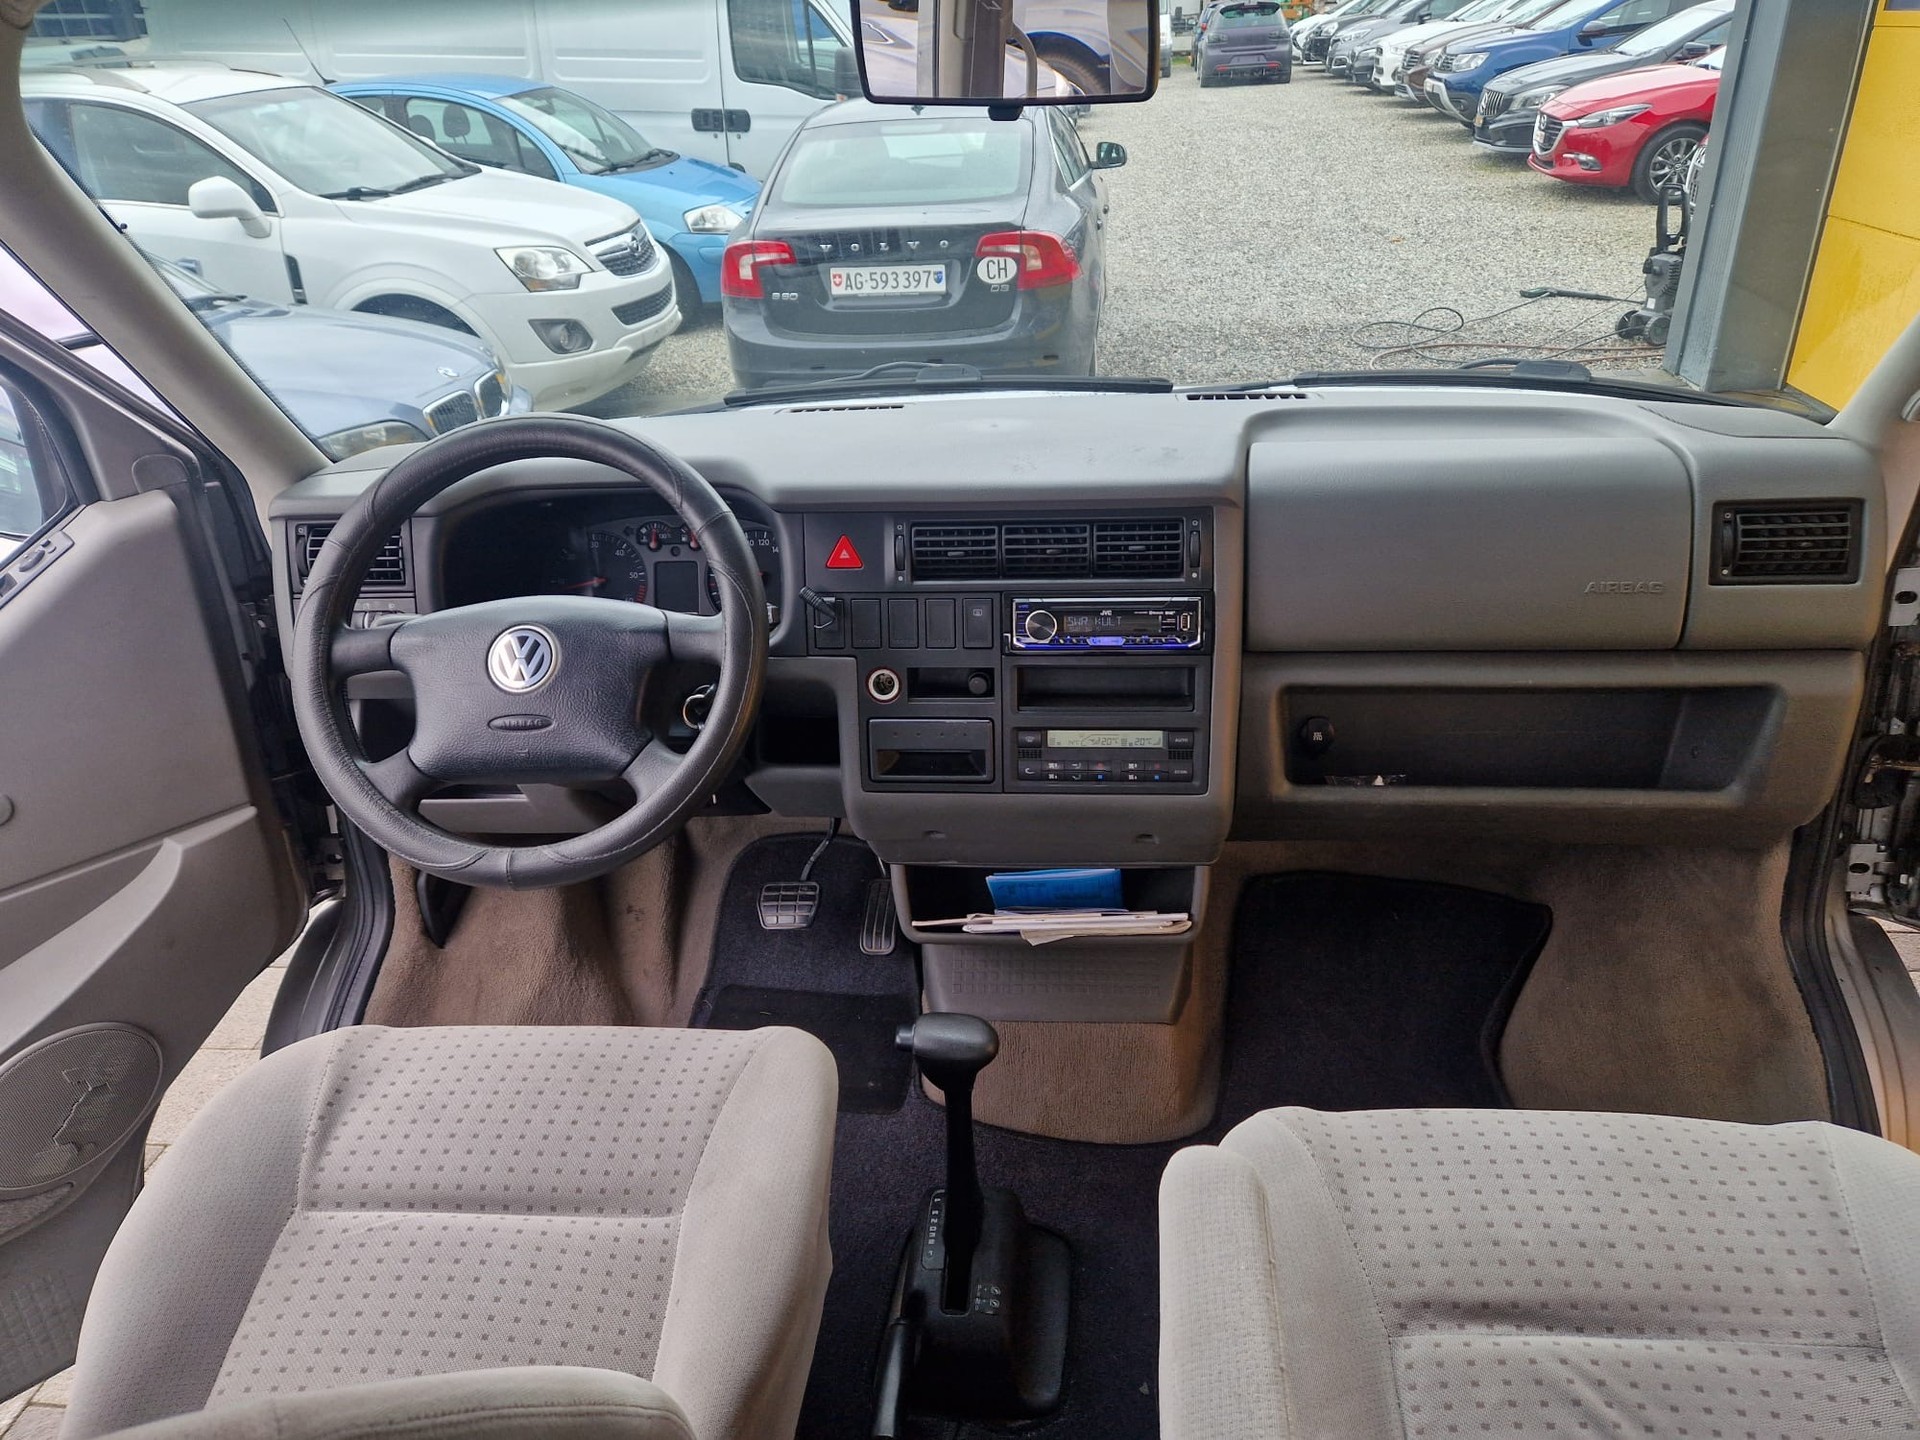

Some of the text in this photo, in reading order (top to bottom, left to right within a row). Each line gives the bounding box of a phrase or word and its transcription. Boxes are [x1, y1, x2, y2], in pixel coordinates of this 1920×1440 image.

[819, 240, 949, 252] VOLVO
[986, 258, 1008, 280] CH
[758, 538, 770, 546] 120
[615, 549, 625, 557] 40
[629, 571, 639, 579] 50
[1584, 581, 1664, 594] AIRBAG
[1068, 616, 1122, 627] SWR KULT
